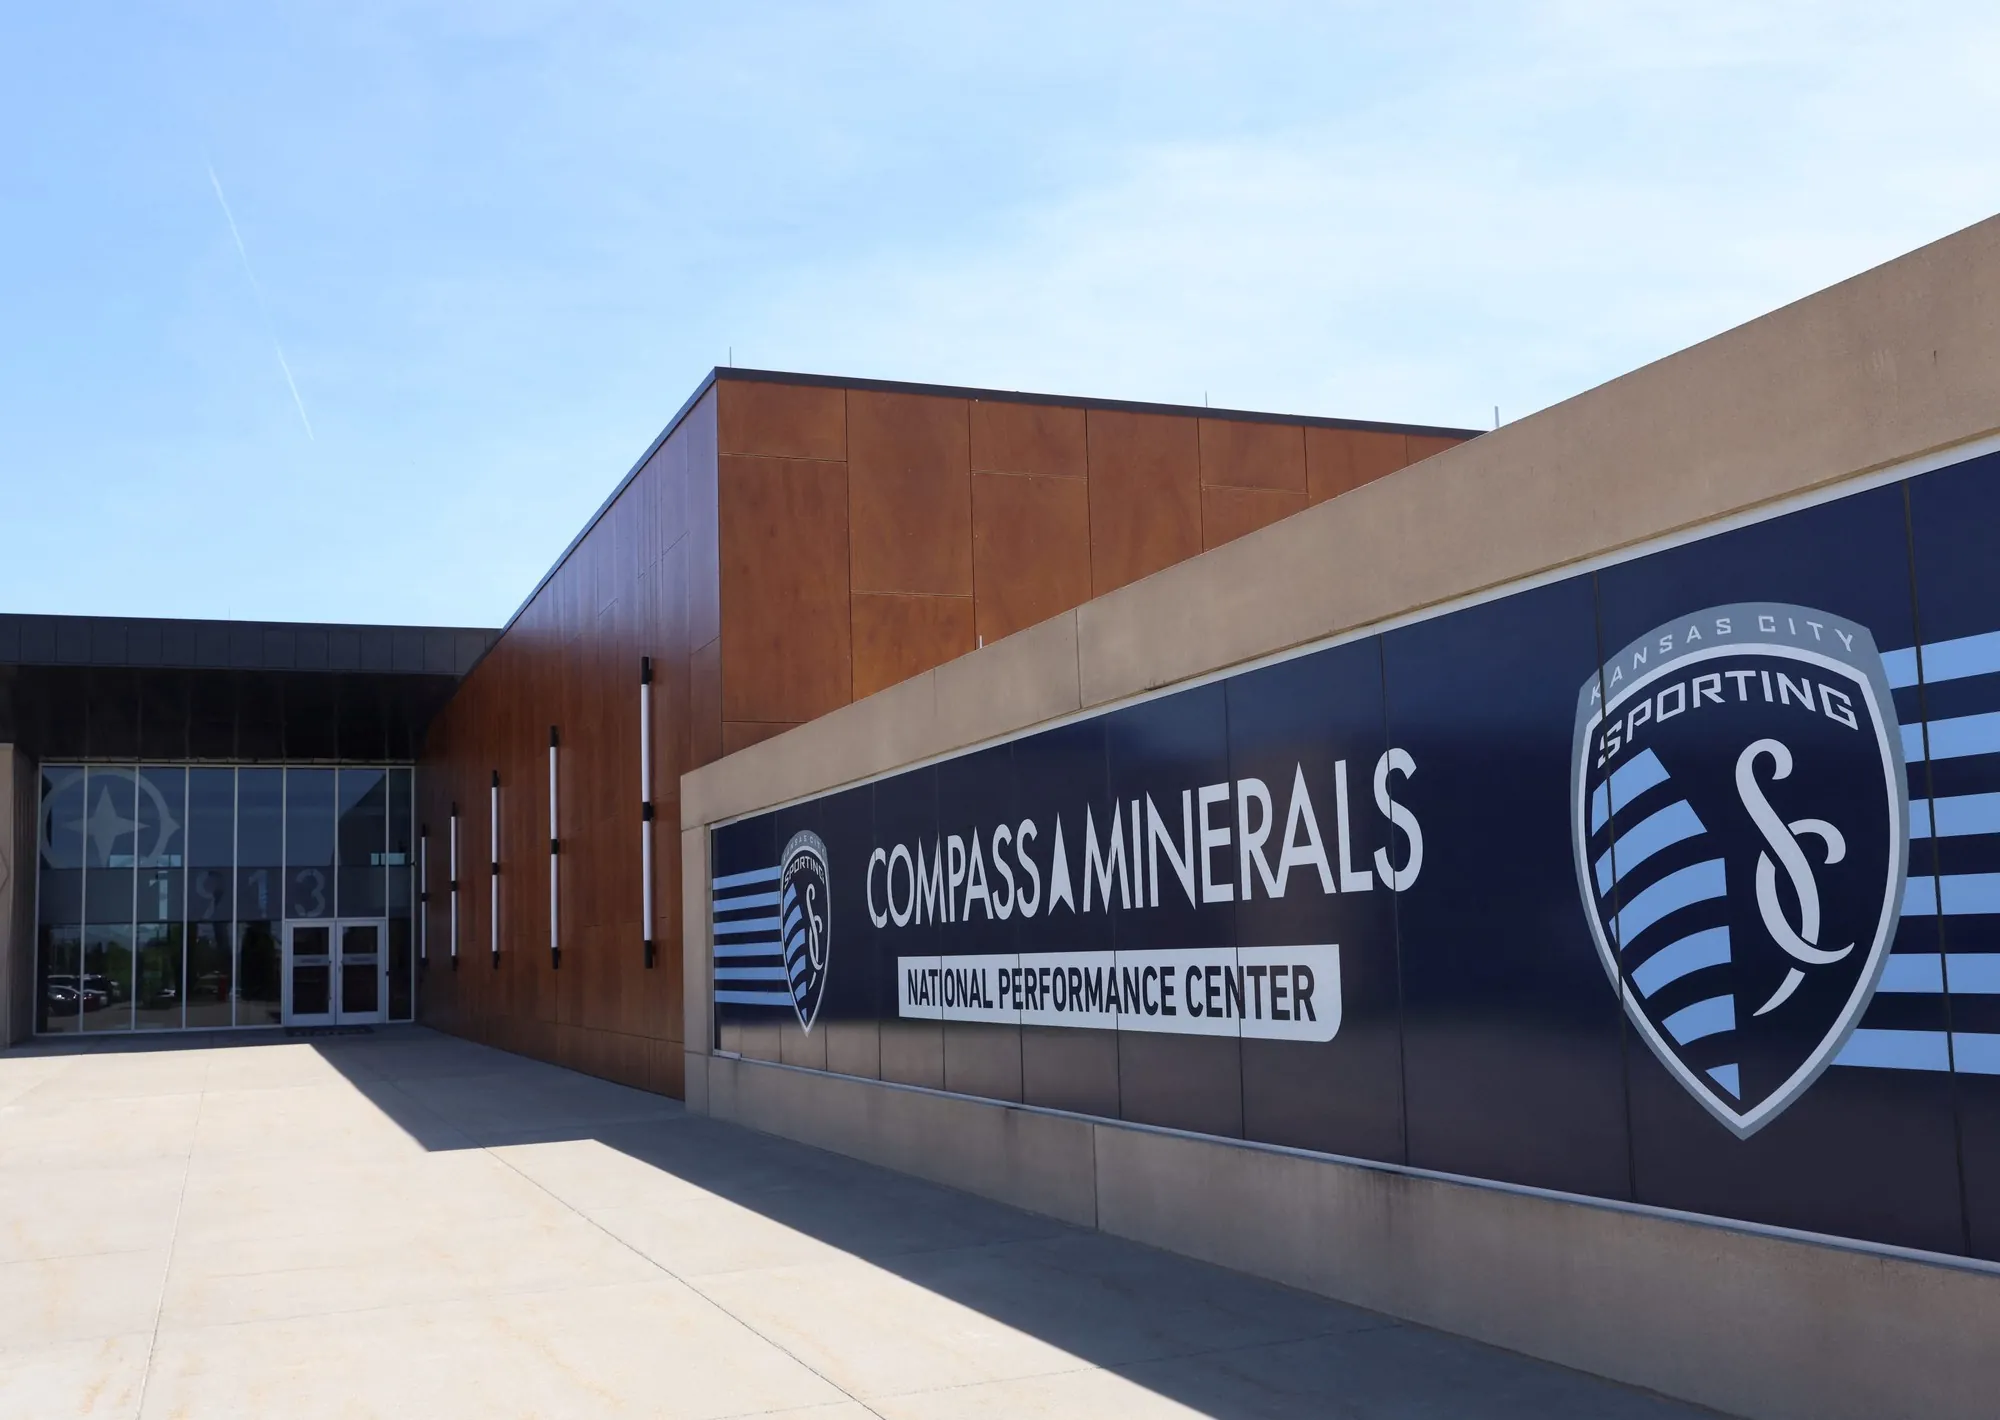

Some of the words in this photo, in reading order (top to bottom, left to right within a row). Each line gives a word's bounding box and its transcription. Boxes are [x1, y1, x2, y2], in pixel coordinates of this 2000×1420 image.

[1590, 616, 1732, 706] KANSAS
[1758, 615, 1854, 653] CITY
[1597, 670, 1859, 769] SPORTING
[784, 856, 825, 890] SPORTING
[866, 818, 1041, 929] COMPASS
[1083, 747, 1424, 914] MINERALS
[907, 968, 994, 1009] NATIONAL
[998, 966, 1177, 1016] PERFORMANCE
[1185, 964, 1317, 1022] CENTER
